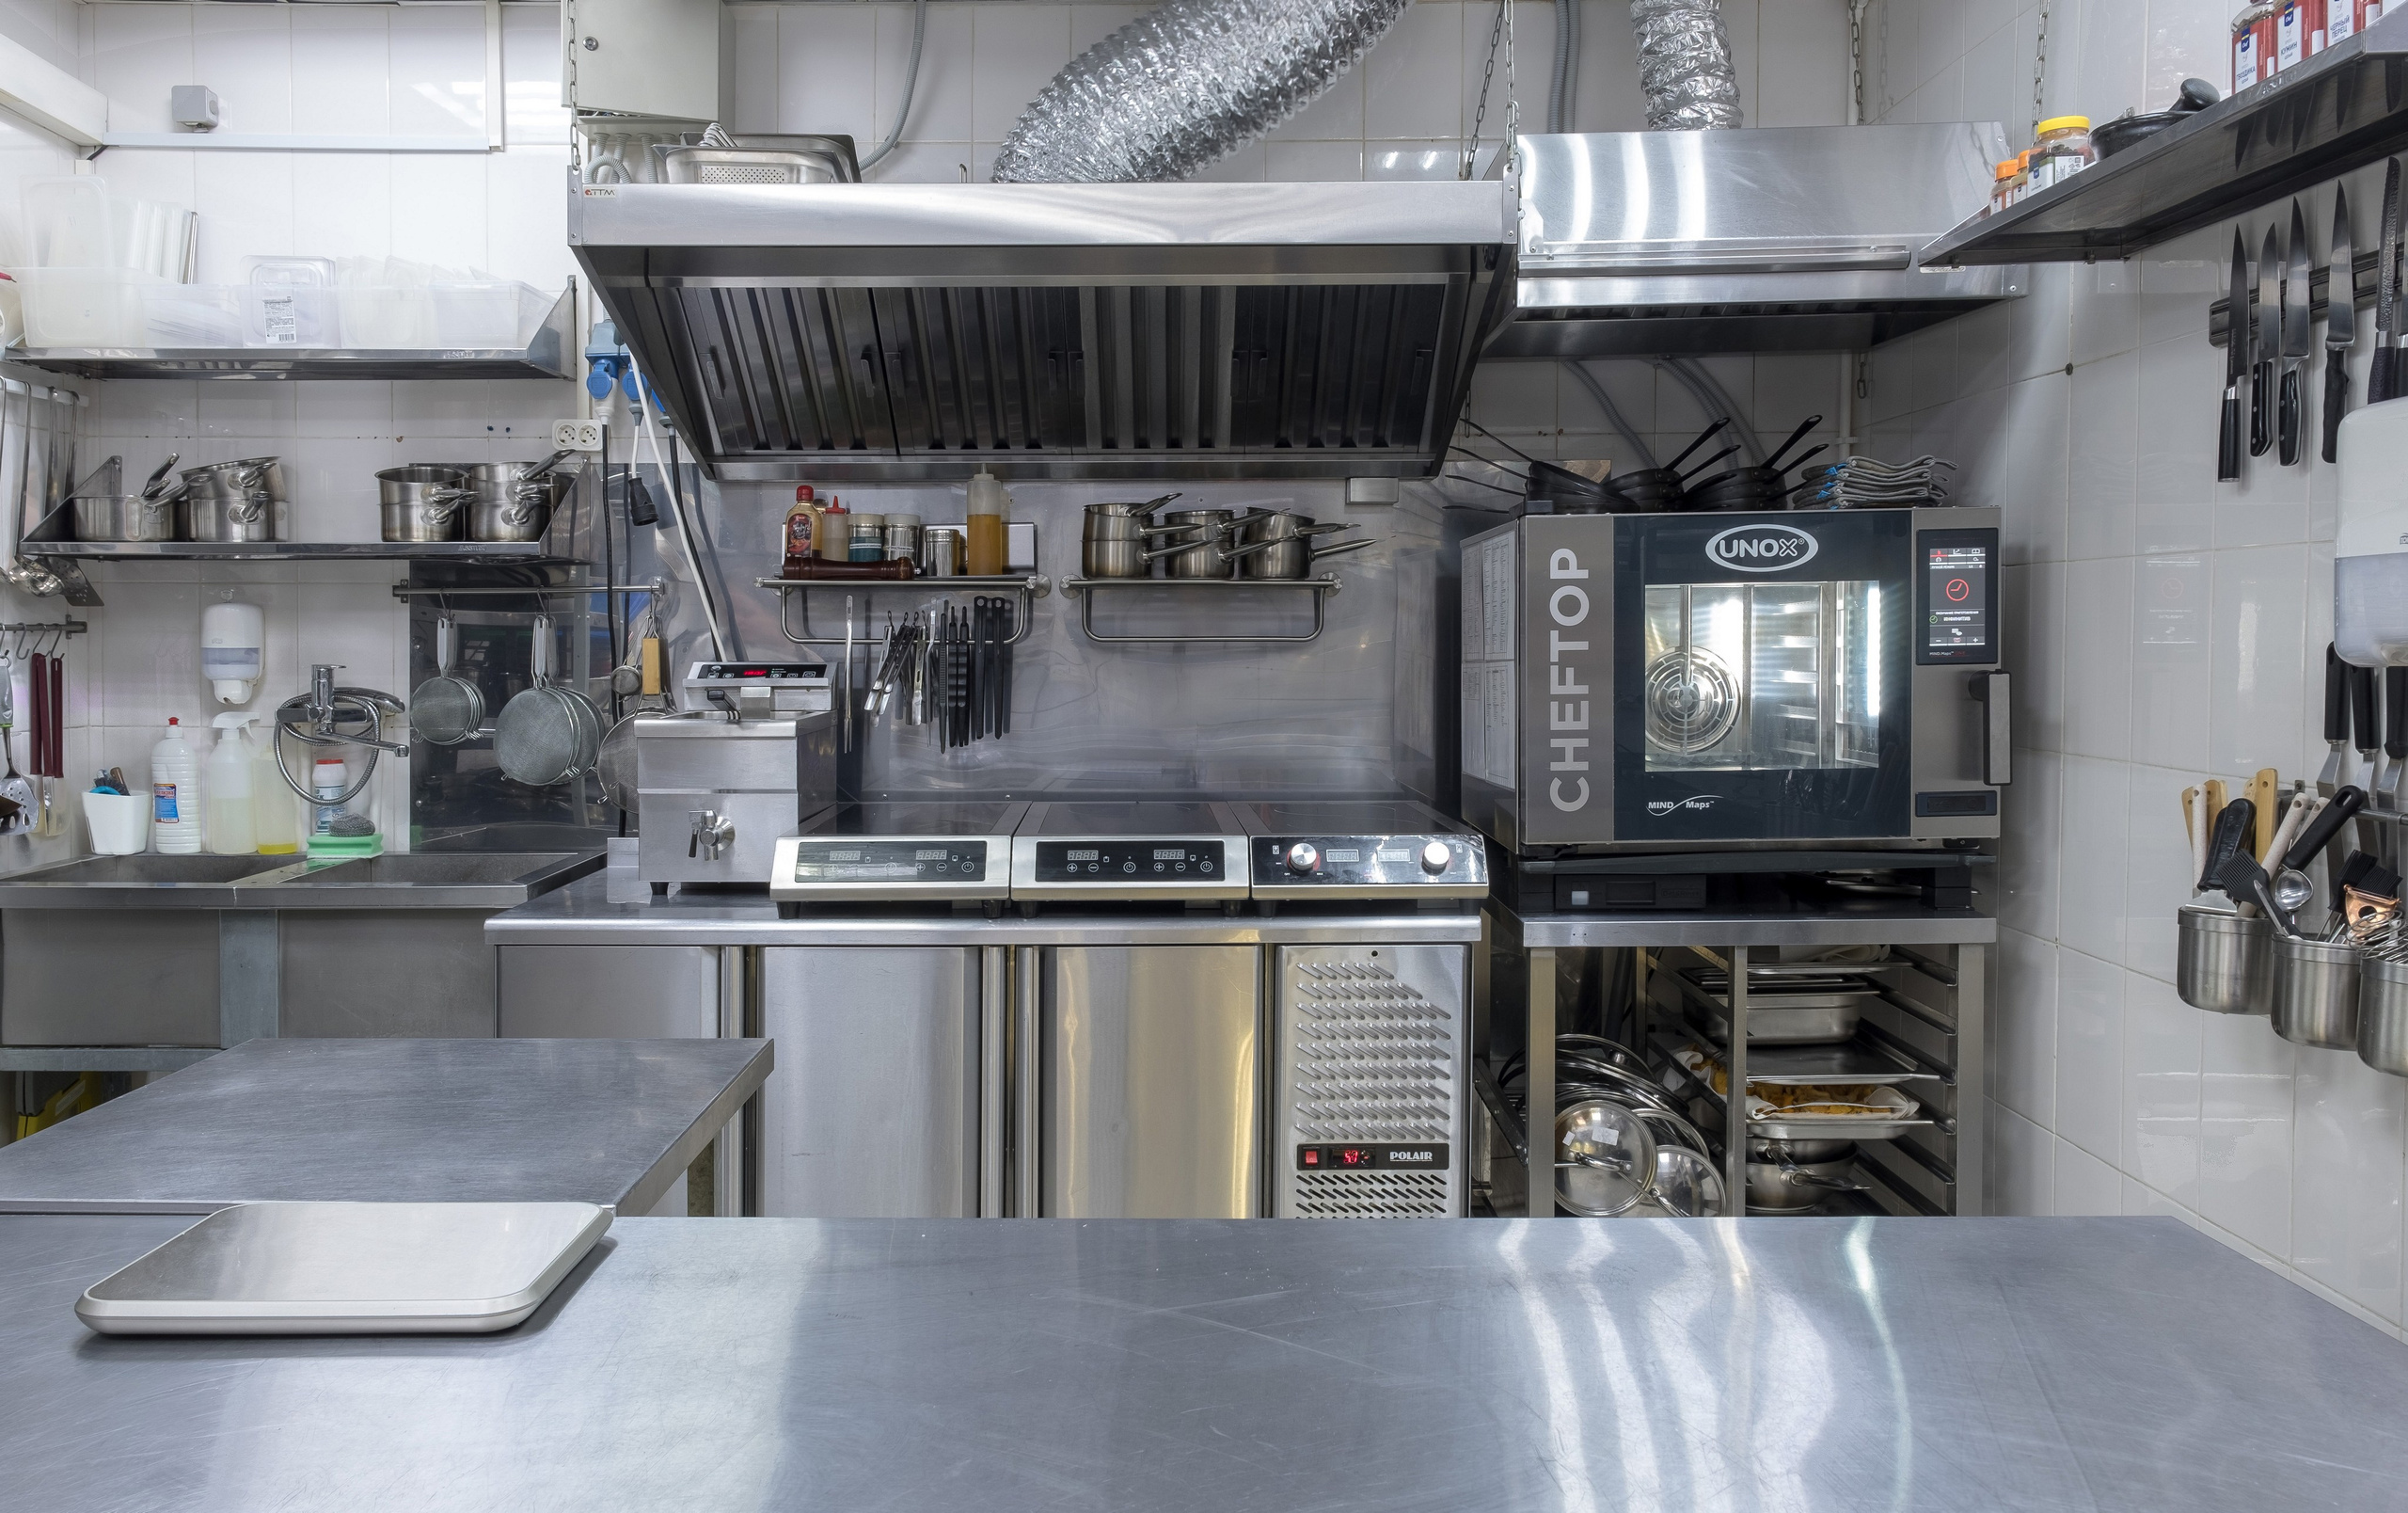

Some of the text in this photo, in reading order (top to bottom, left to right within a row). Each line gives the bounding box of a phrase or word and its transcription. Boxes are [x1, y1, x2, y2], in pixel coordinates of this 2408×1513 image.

[2331, 25, 2348, 39] ПЕРЕЦ
[2280, 41, 2298, 56] КУМИН
[2236, 66, 2256, 80] ГВОЗДИКА
[1549, 548, 1590, 812] CHEFTOP
[1648, 801, 1674, 809] MIND
[1389, 1151, 1433, 1160] POLAIR
